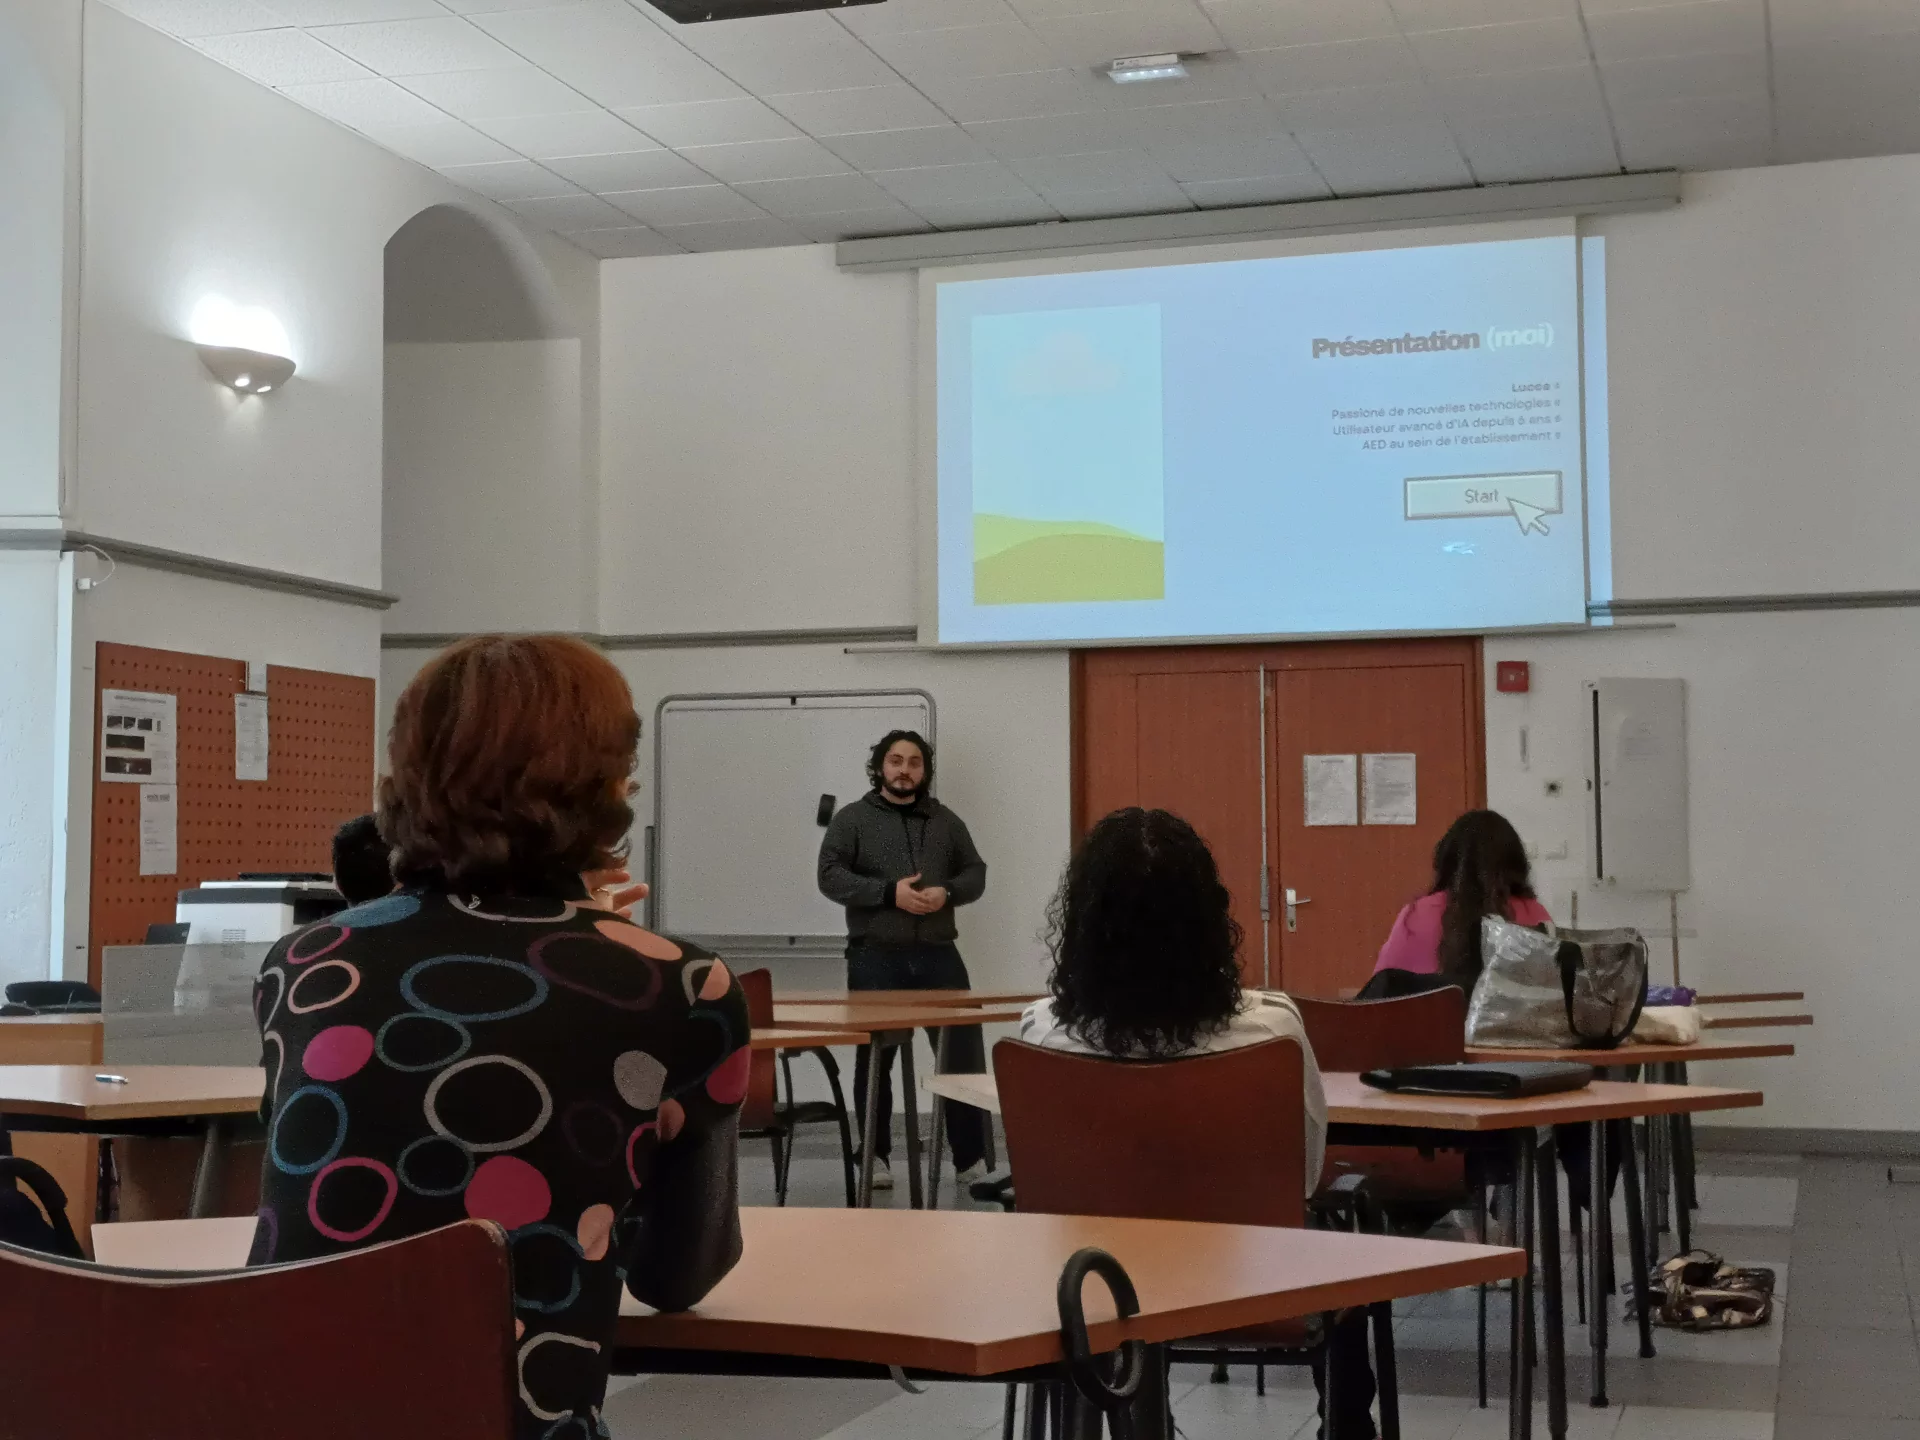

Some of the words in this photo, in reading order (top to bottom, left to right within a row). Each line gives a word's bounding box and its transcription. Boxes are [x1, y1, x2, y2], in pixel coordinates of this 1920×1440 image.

[1312, 330, 1480, 358] Présentation
[1487, 321, 1553, 351] (moi)
[1388, 405, 1405, 417] de
[1407, 403, 1466, 415] nouvelles
[1468, 399, 1552, 412] technologies
[1333, 424, 1396, 435] Utilisateur
[1399, 420, 1443, 432] avancé
[1472, 416, 1515, 429] depuis
[1362, 440, 1387, 450] AED
[1389, 440, 1405, 449] au
[1407, 436, 1433, 448] sein
[1435, 435, 1452, 446] de
[1464, 488, 1499, 504] Start
